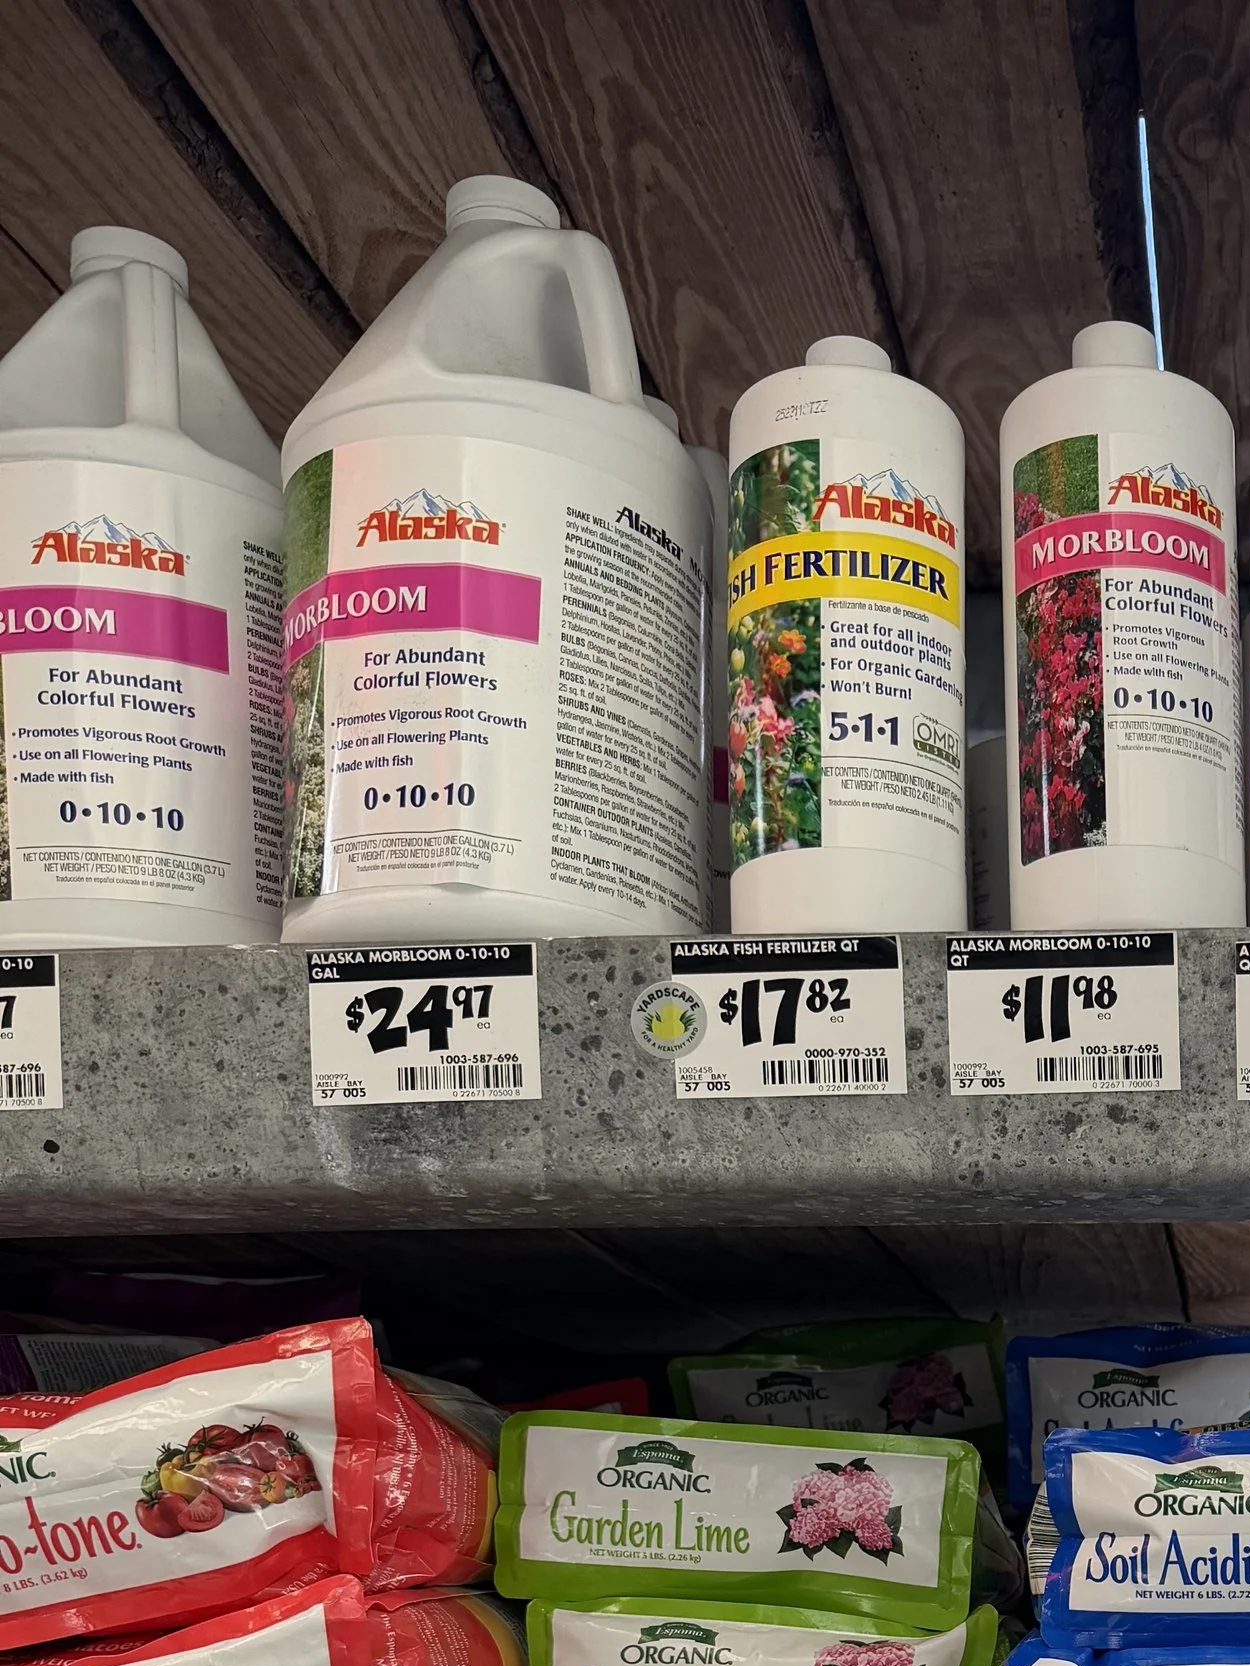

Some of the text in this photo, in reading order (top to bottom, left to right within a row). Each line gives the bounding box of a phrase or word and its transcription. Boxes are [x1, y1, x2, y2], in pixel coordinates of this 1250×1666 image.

[1108, 475, 1222, 530] Alaska
[812, 484, 956, 550] Alaska
[357, 510, 500, 548] Alaska
[1032, 529, 1210, 571] MORBLOOM
[765, 550, 949, 601] FERTILIZER
[1105, 578, 1214, 611] For Abundant
[284, 585, 426, 649] MORBLOOM
[1105, 596, 1228, 638] Colorful Flowers
[364, 647, 486, 668] For Abundant
[353, 671, 498, 692] Colorful Flowers
[830, 679, 912, 700] Won't Burn!
[917, 722, 959, 756] OMRI
[336, 754, 413, 774] Made with fish
[674, 939, 859, 957] ALASKA FISH FERTILIZER QT
[951, 936, 1151, 952] ALASKA MORBLOOM 0-10-10
[311, 947, 510, 965] ALASKA MORBLOOM 0-10-10
[951, 955, 969, 967] QT
[312, 968, 340, 979] GAL
[637, 987, 700, 1015] YARDSCAPE
[440, 1054, 519, 1065] 1003-587-696
[805, 1048, 886, 1058] 0000-970-352
[1080, 1044, 1159, 1055] 1003-587-695
[1078, 1388, 1178, 1409] ORGANIC
[597, 1467, 711, 1494] ORGANIC
[550, 1490, 750, 1554] Garden Lime
[1084, 1531, 1149, 1585] Soil
[621, 1644, 732, 1666] ORGANIC
